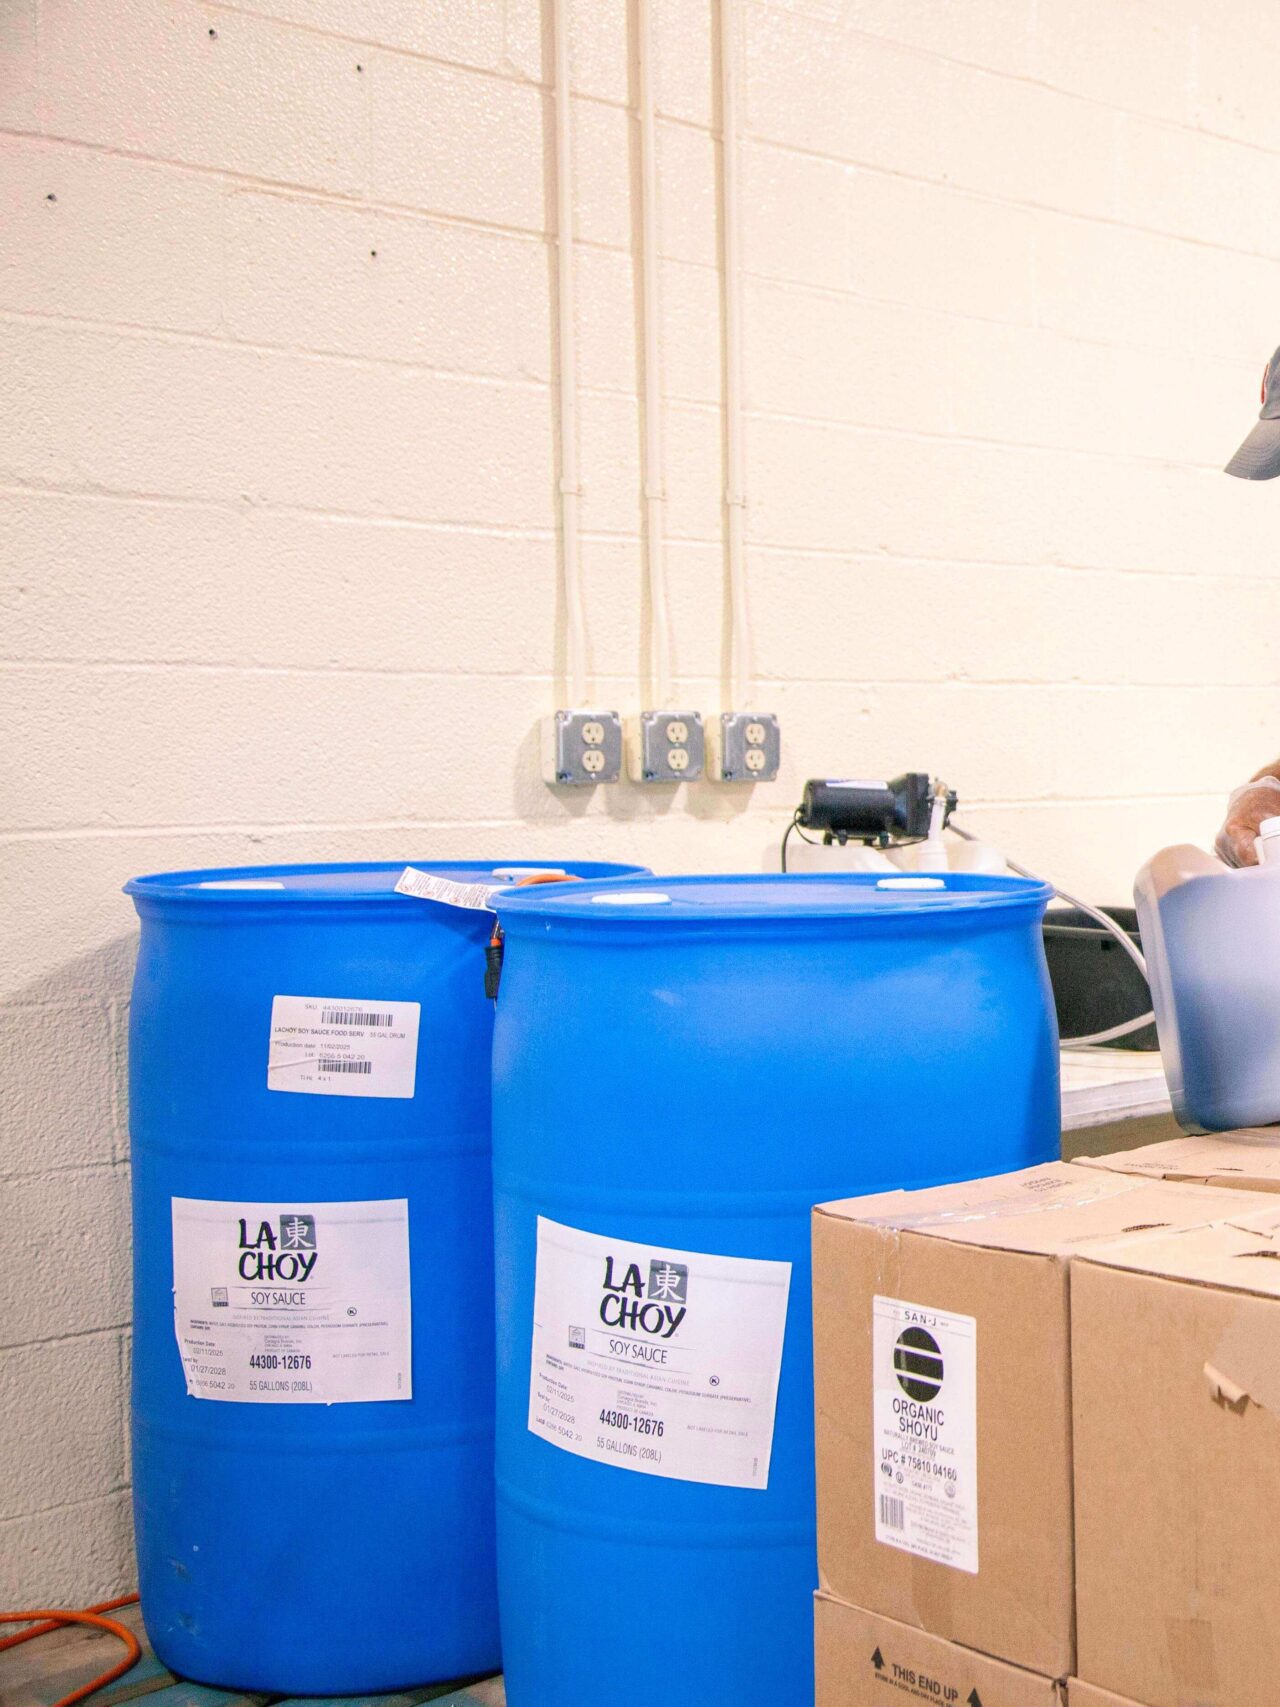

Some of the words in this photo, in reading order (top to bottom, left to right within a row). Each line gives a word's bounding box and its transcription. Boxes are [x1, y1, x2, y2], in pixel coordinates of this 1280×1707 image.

[239, 1218, 278, 1250] LA
[286, 1217, 316, 1249] 東
[238, 1251, 318, 1283] CHOY
[603, 1256, 645, 1298] LA
[650, 1264, 684, 1301] 東
[251, 1292, 271, 1306] SOY
[272, 1292, 306, 1306] SAUCE
[600, 1293, 687, 1338] CHOY
[904, 1310, 937, 1327] SAN-J
[249, 1354, 312, 1369] 44300-12676
[609, 1339, 632, 1357] SOY
[632, 1342, 668, 1364] SAUCE
[190, 1365, 226, 1375] 01/27/2028
[209, 1380, 226, 1389] 5042
[249, 1381, 257, 1390] 55
[259, 1381, 289, 1391] GALLONS
[291, 1381, 312, 1393] (208L)
[546, 1385, 574, 1402] 02/11/2025
[544, 1403, 575, 1424] 01/27/2028
[600, 1409, 664, 1437] 44300-12676
[892, 1398, 945, 1426] ORGANIC
[558, 1427, 573, 1439] 5042
[899, 1416, 938, 1441] SHOYU
[597, 1437, 604, 1448] 55
[606, 1438, 637, 1457] GALLONS
[639, 1448, 662, 1463] (208L)
[882, 1448, 898, 1463] UPC
[901, 1454, 905, 1464] #
[908, 1456, 931, 1473] 75810
[933, 1463, 957, 1481] 04160
[892, 1664, 916, 1684] THIS
[919, 1675, 941, 1695] END
[944, 1686, 958, 1701] UP
